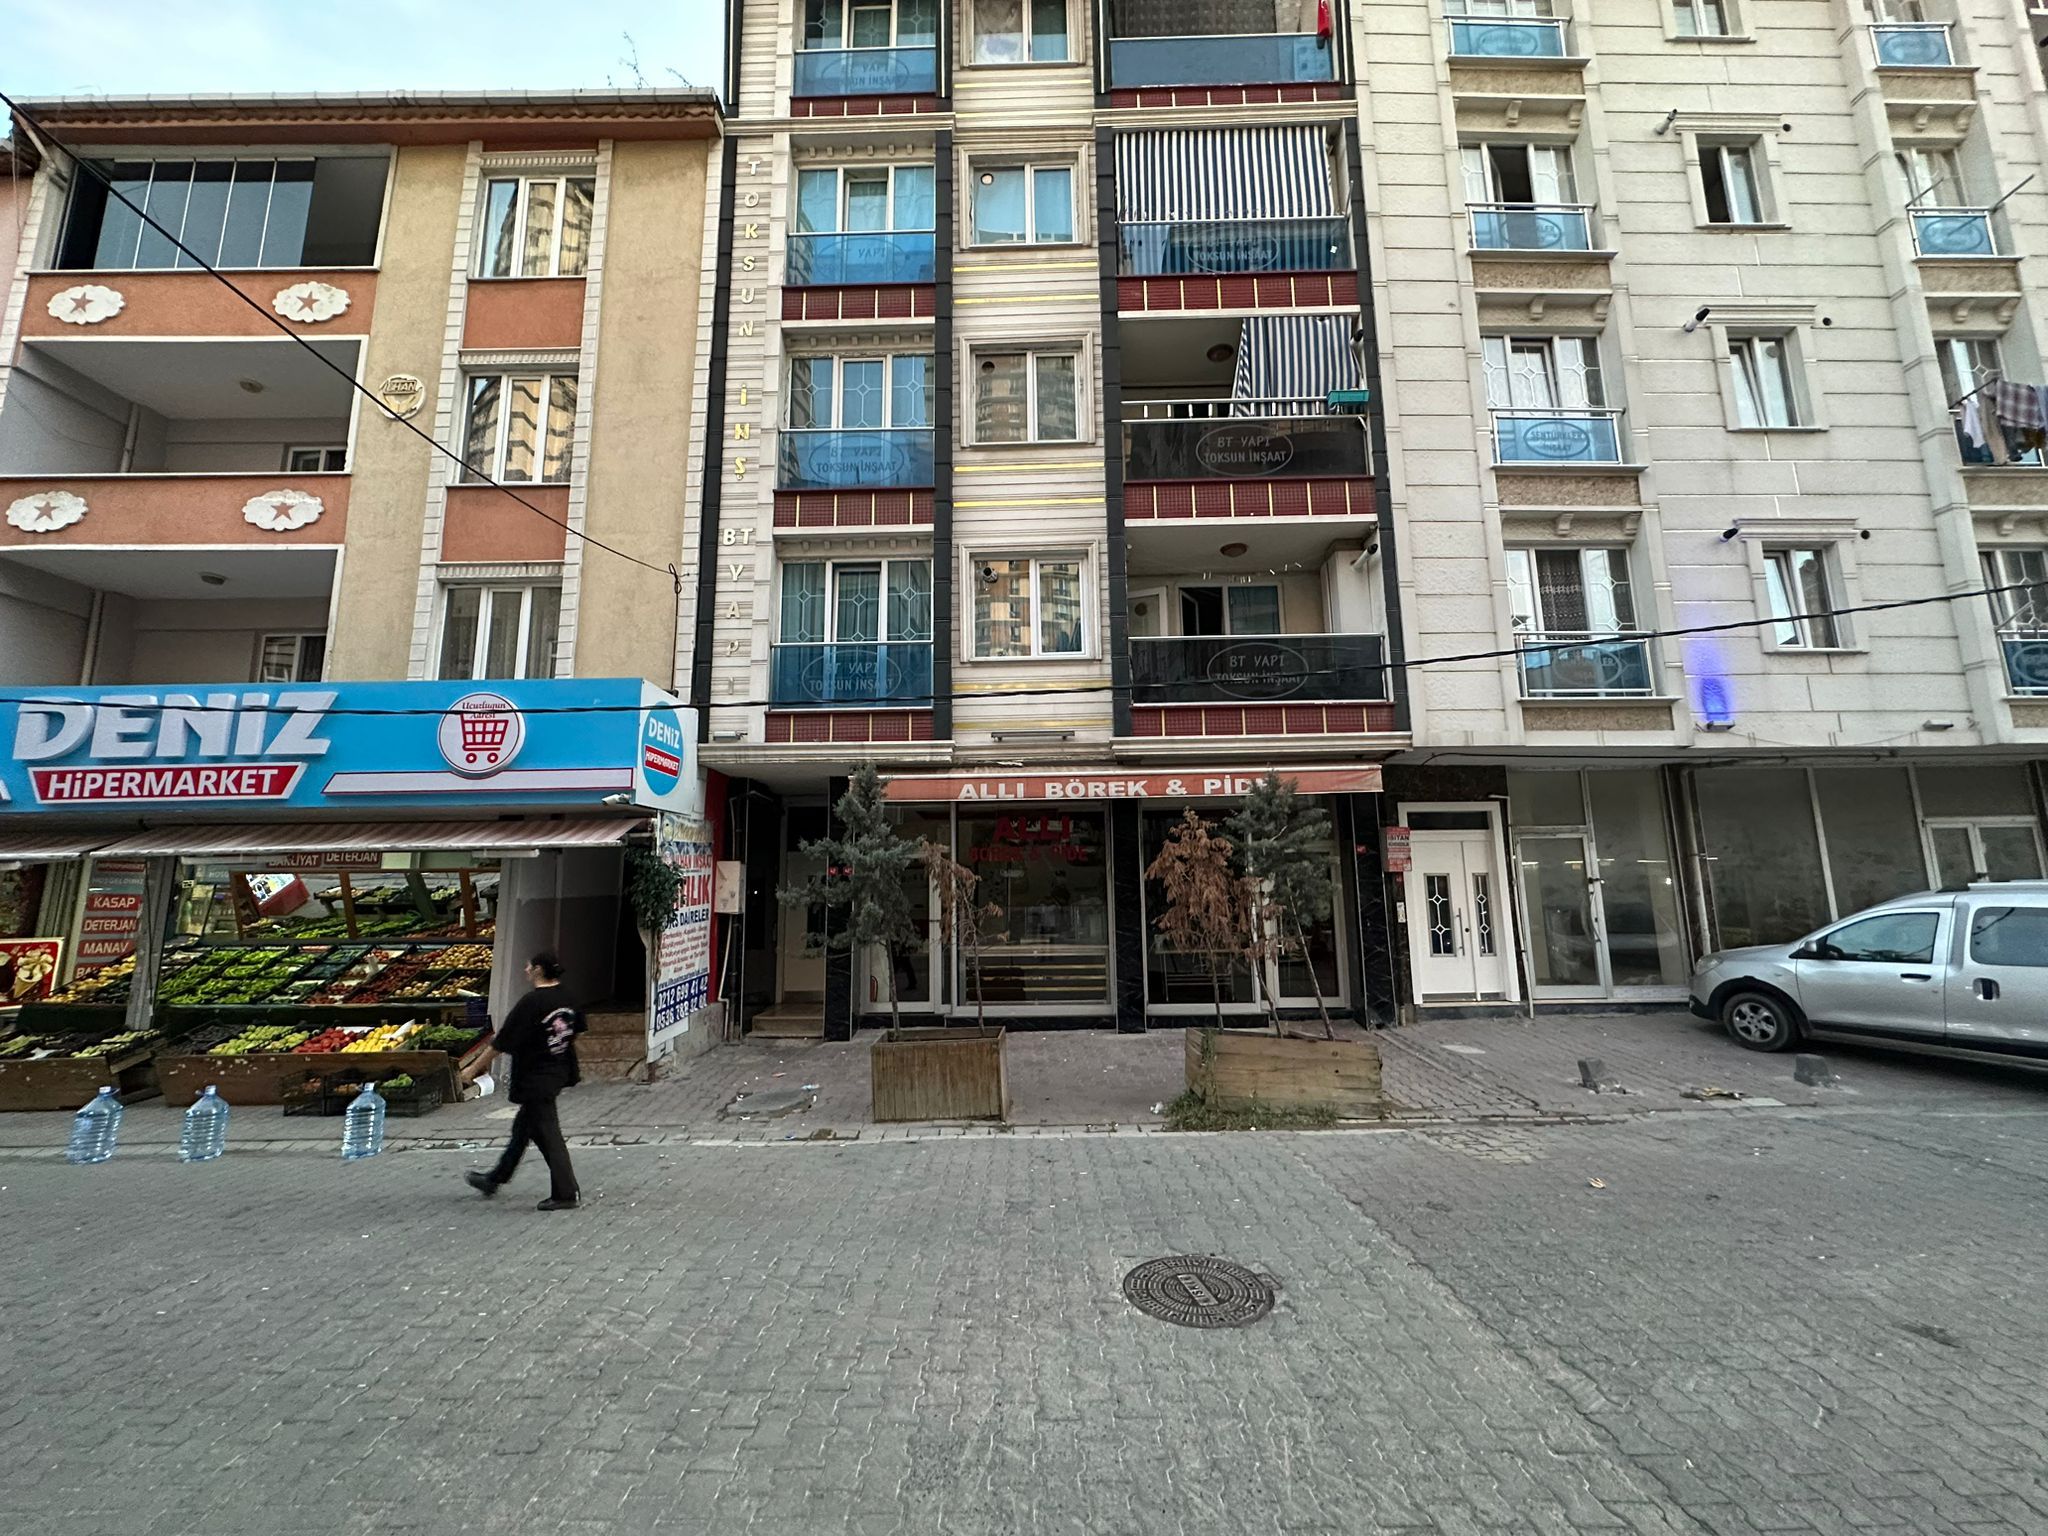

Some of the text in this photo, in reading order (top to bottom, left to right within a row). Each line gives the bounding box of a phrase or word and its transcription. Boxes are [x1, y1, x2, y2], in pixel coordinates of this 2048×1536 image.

[734, 160, 761, 481] TOKSUN İNŞ
[1217, 436, 1272, 448] BT YAPI
[1204, 449, 1287, 465] TOKSUN İNŞAAT
[816, 462, 856, 473] TOKSUN
[722, 527, 754, 547] BT
[1229, 655, 1285, 668] BT YAPI
[958, 782, 1025, 800] ALLI
[1045, 778, 1148, 798] BÖREK
[1165, 779, 1188, 796] &
[993, 816, 1070, 842] ALLI
[93, 897, 136, 909] KASAP
[84, 919, 136, 932] DETERJAN
[83, 942, 130, 955] MANAV
[658, 988, 676, 1011] 0212
